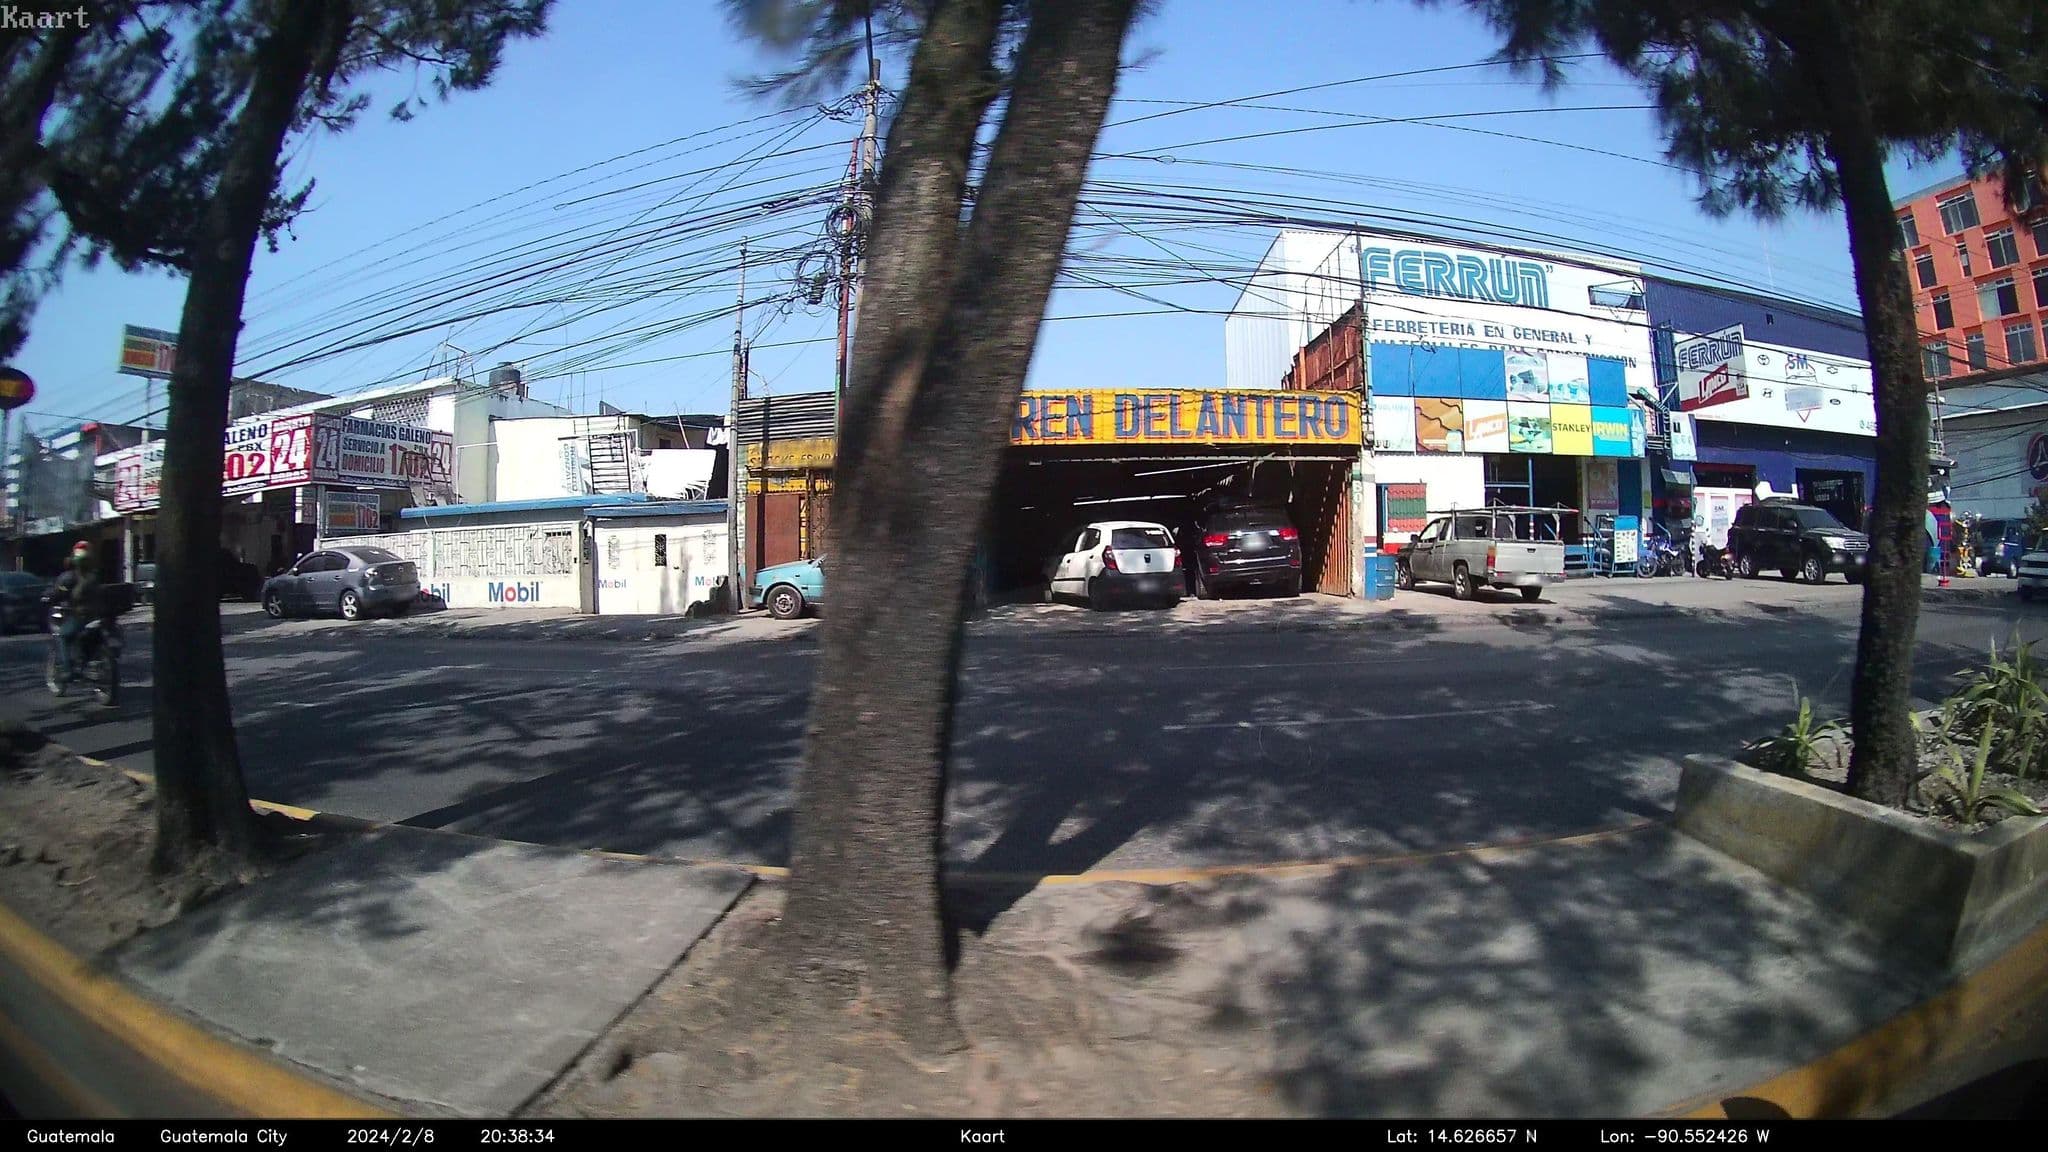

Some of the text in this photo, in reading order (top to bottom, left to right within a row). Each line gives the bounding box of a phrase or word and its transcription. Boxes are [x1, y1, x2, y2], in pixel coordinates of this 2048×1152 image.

[1372, 318, 1593, 345] FERRETERIA EN GENERAL Y
[1011, 393, 1350, 442] REN DELANTERO
[1552, 422, 1591, 433] STANLEY
[223, 423, 268, 444] ALENO
[342, 418, 398, 441] FARMACIAS
[399, 426, 432, 444] GALENO
[342, 437, 379, 454] SERVICIO
[342, 453, 386, 474] DOMICILIO
[488, 582, 540, 602] Mobil
[599, 579, 627, 589] Mobil
